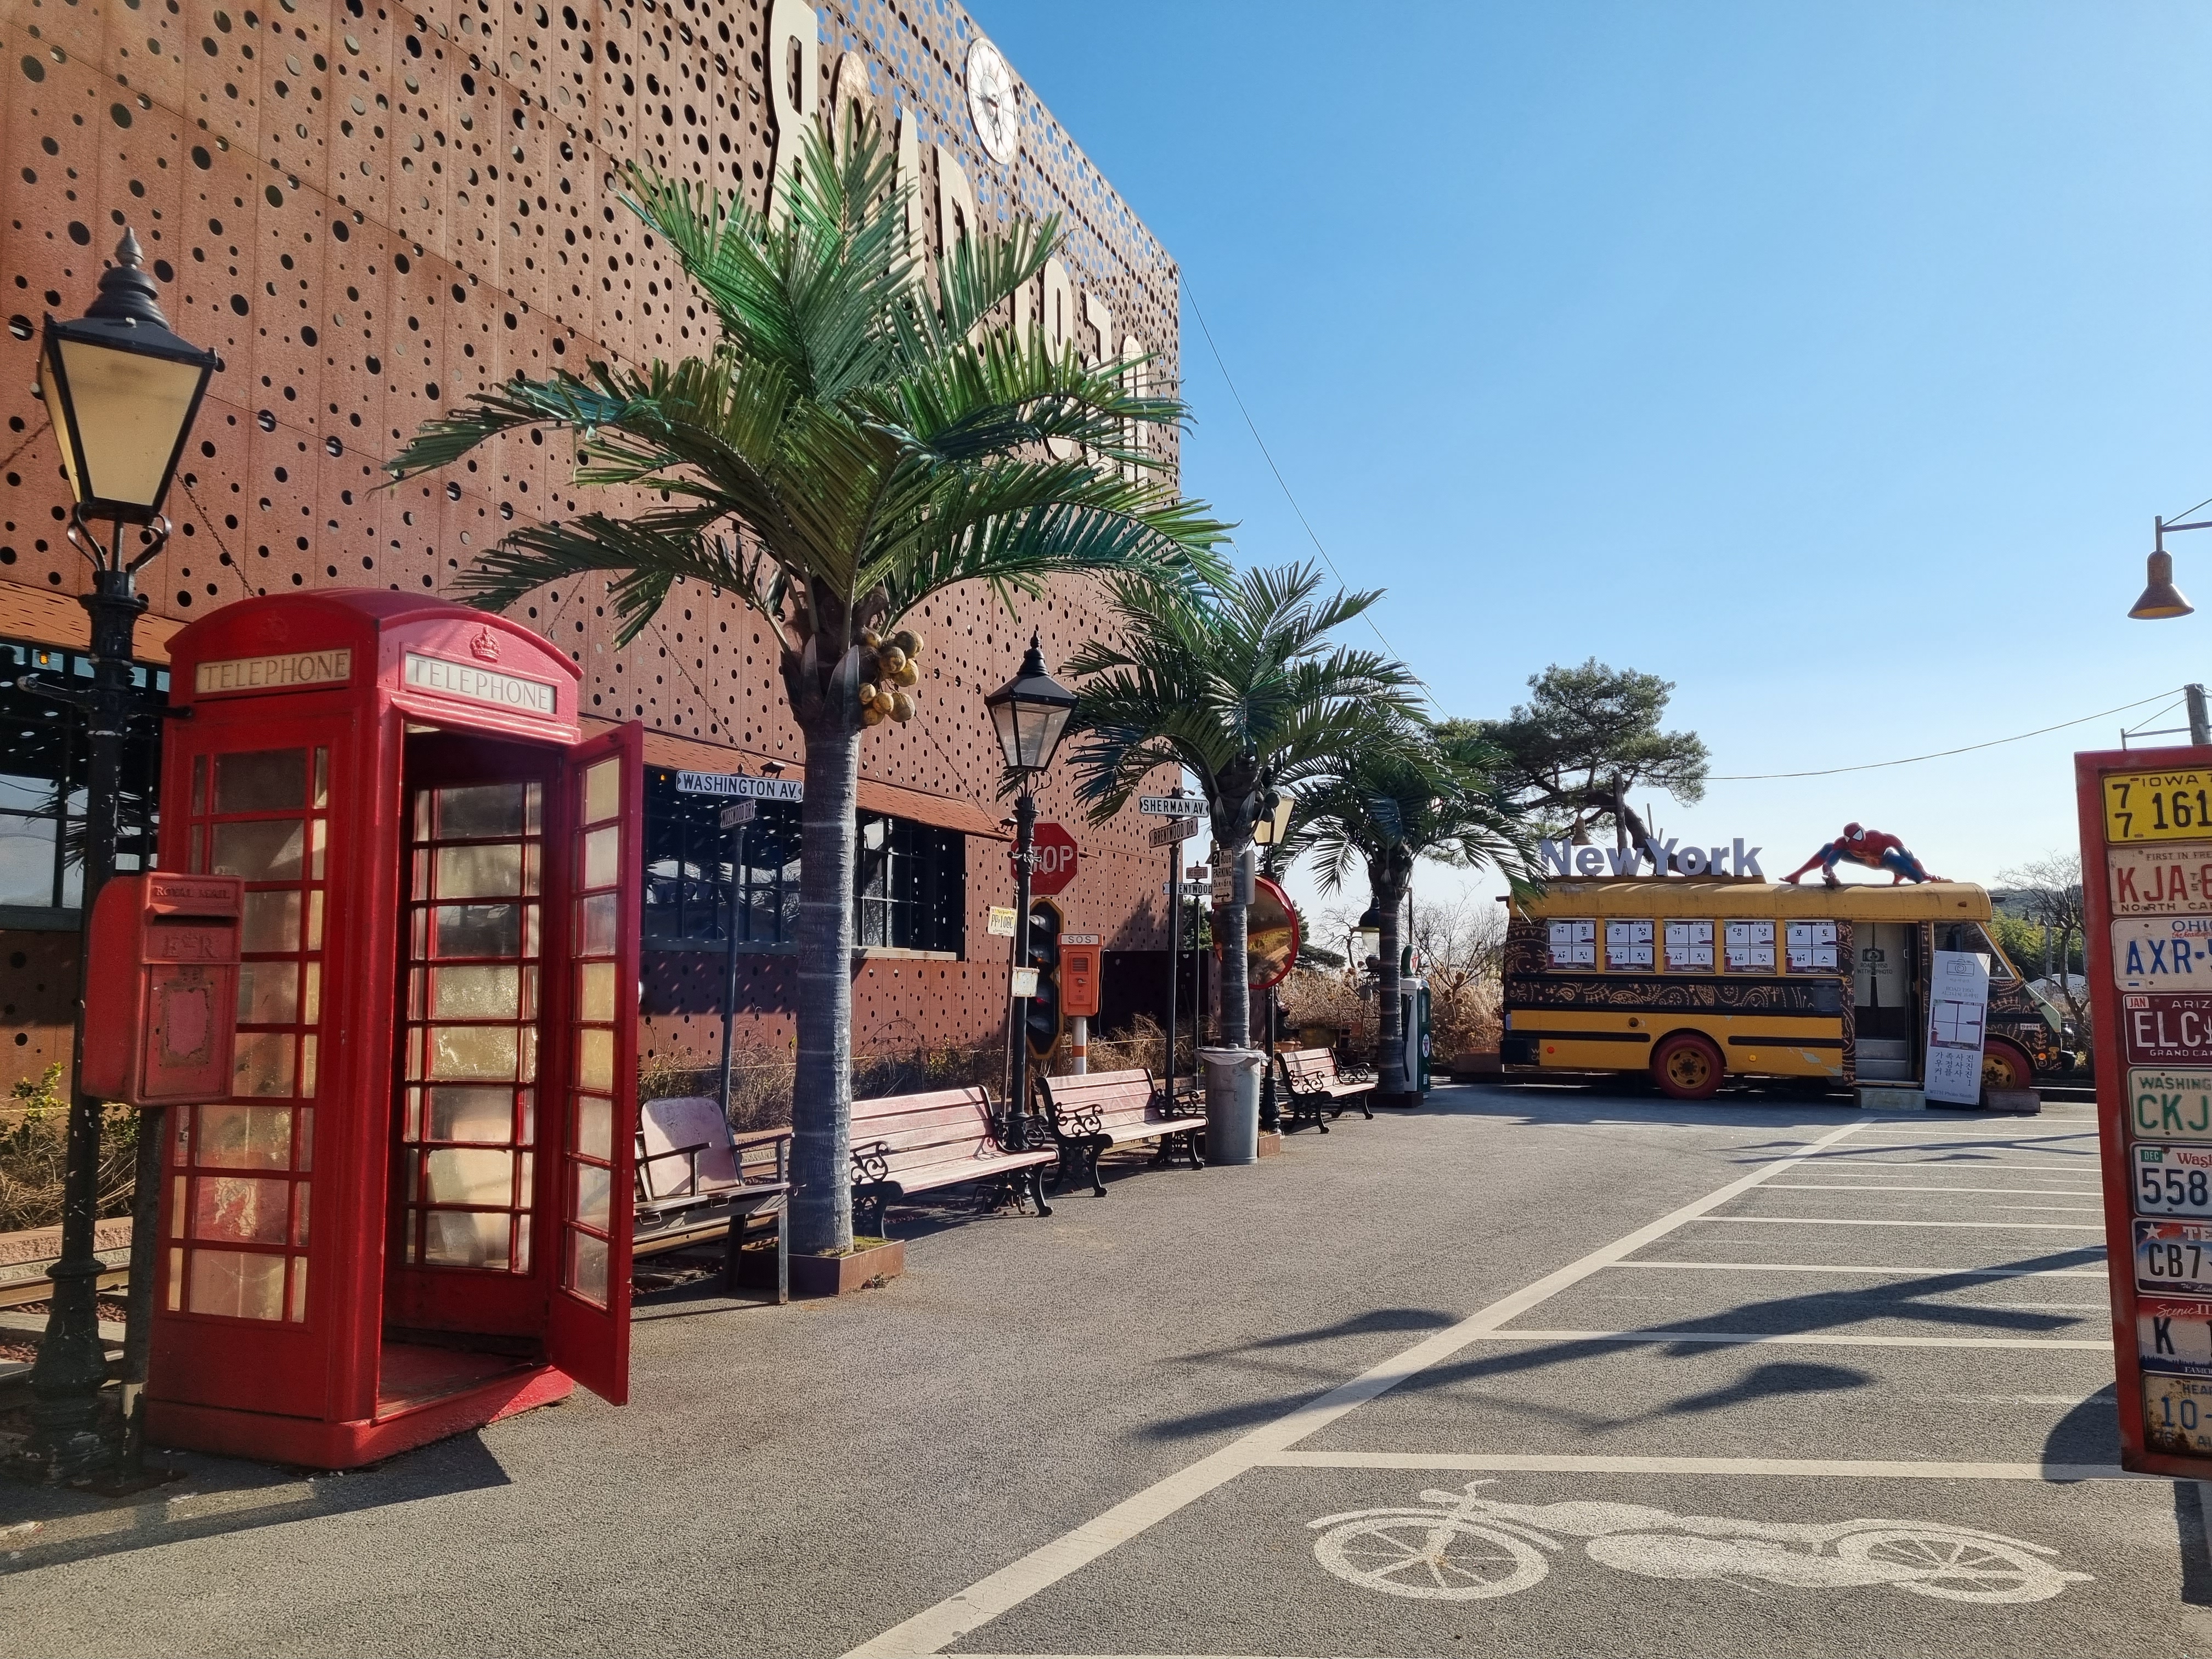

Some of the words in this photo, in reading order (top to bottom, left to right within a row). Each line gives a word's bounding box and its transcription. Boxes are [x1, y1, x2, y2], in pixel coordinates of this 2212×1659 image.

[204, 650, 348, 690] TELEPHONE
[408, 654, 549, 711] TELEPHONE
[684, 774, 775, 797] WASHINGTON
[780, 782, 797, 798] AV.
[2142, 775, 2199, 787] IOWA
[1143, 799, 1190, 813] SHERMAN
[1193, 802, 1205, 815] AV.
[2152, 789, 2212, 830] 161
[1154, 823, 1184, 845] BRENTWOOD
[1014, 845, 1074, 873] TOP
[1213, 854, 1218, 865] 2
[1221, 855, 1232, 864] HOUR
[2146, 853, 2173, 861] FIRST
[1213, 867, 1232, 878] PARKING
[1179, 884, 1212, 894] ENTWOOD
[2117, 865, 2190, 902] KJA
[155, 886, 194, 898] ROYAL
[199, 889, 230, 899] MAIL
[2121, 903, 2176, 912] NORTH
[1615, 927, 1646, 936] 우정
[1673, 927, 1706, 937] 가족
[1733, 927, 1768, 936] 댕냥
[2172, 920, 2212, 932] OHI
[1795, 929, 1830, 937] 포토
[1068, 935, 1092, 944] SOS
[1796, 953, 1829, 963] 버스
[2129, 998, 2146, 1008] JAN
[2137, 1093, 2209, 1131] CKJ
[2144, 1150, 2159, 1160] DEC
[2142, 1168, 2208, 1206] 558
[2148, 1243, 2201, 1279] CB7
[2156, 1304, 2196, 1317] Scenic
[2153, 1317, 2175, 1355] K
